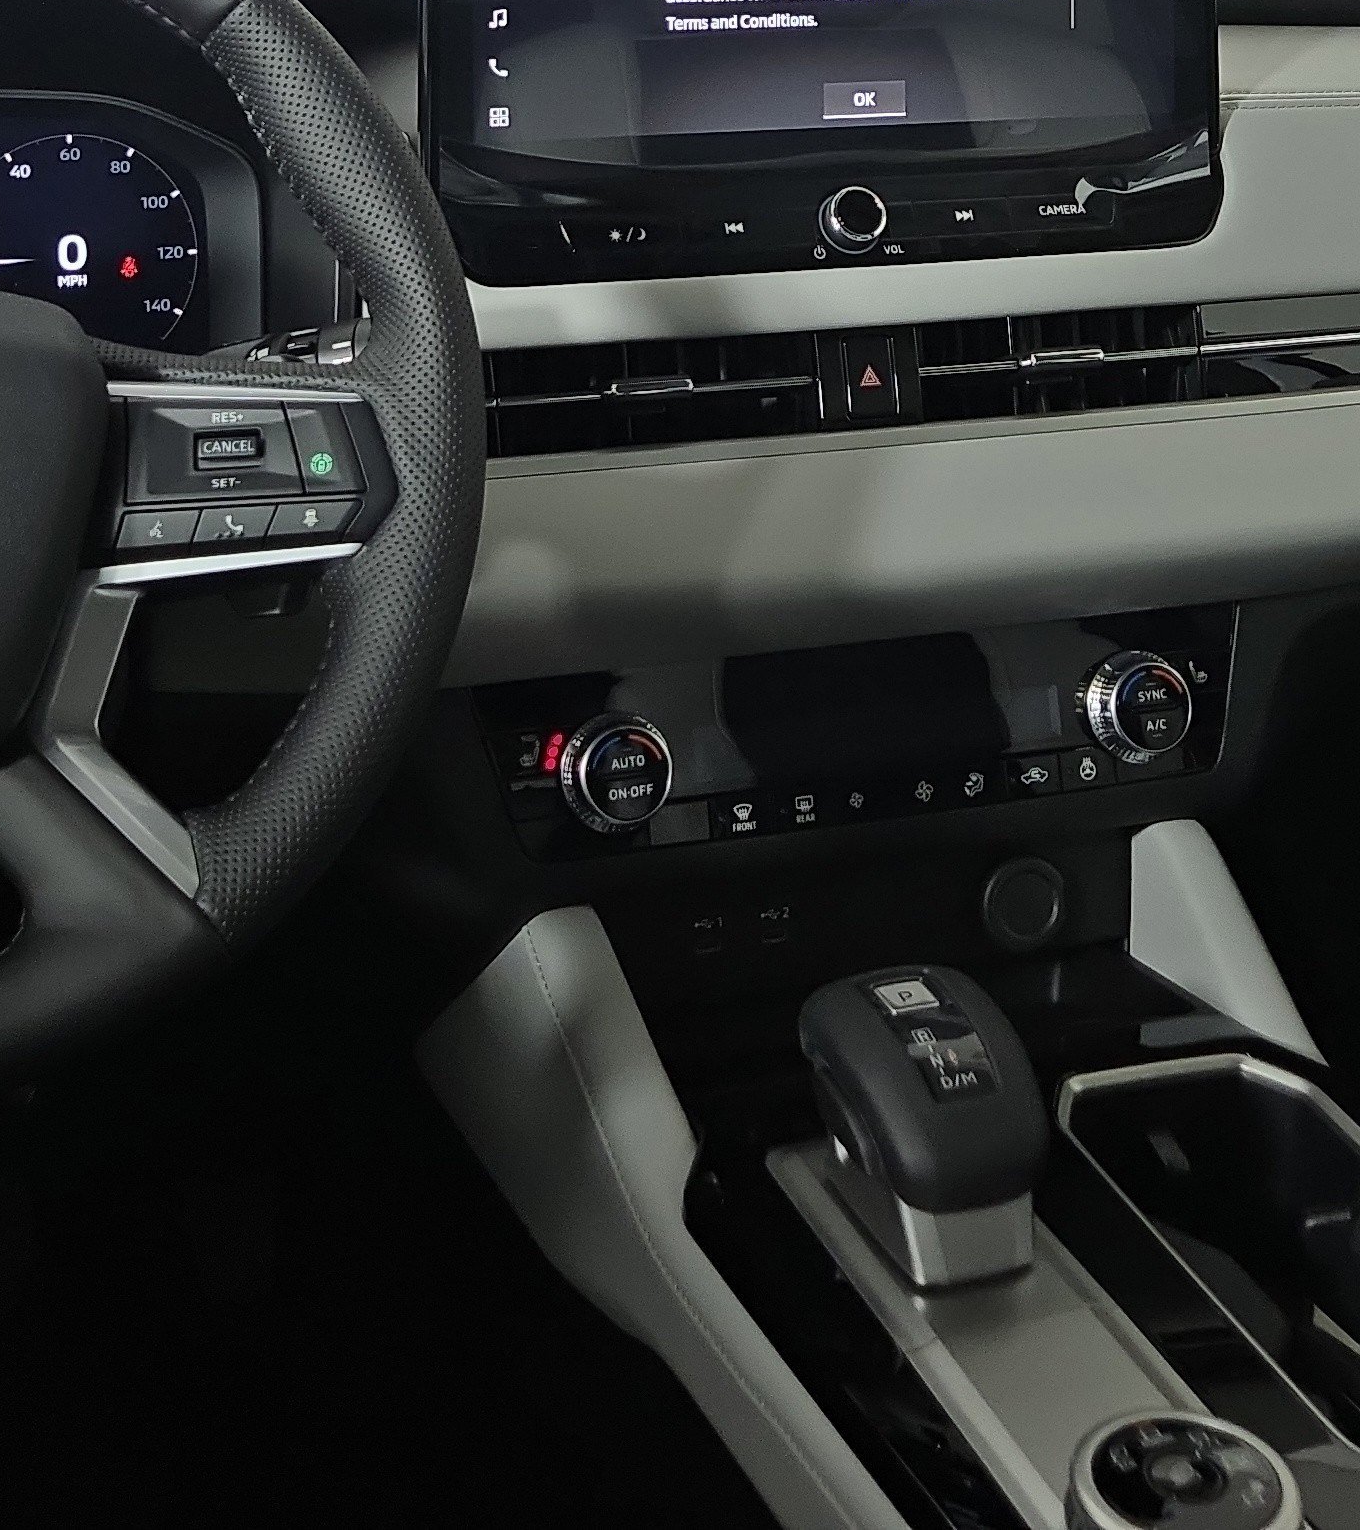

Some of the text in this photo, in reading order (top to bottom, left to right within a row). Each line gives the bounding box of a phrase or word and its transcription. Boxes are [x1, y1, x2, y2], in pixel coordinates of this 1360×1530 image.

[665, 13, 819, 31] Terms and Conditions.
[853, 91, 877, 108] OK
[59, 146, 81, 162] 60
[9, 163, 32, 180] 40
[109, 159, 131, 175] 80
[140, 194, 169, 210] 100
[1038, 202, 1087, 216] CAMERA
[56, 233, 88, 271] 0
[156, 245, 184, 260] 120
[883, 243, 905, 255] VOL
[56, 273, 88, 288] MPH
[143, 297, 171, 313] 140
[202, 439, 255, 454] CANCEL
[1137, 688, 1168, 703] SYNC
[1145, 718, 1168, 732] A/C
[610, 754, 645, 771] AUTO
[795, 812, 816, 824] REAR
[731, 820, 757, 833] FRONT
[897, 990, 913, 1002] P
[929, 1053, 944, 1068] N
[940, 1070, 979, 1090] D/M
